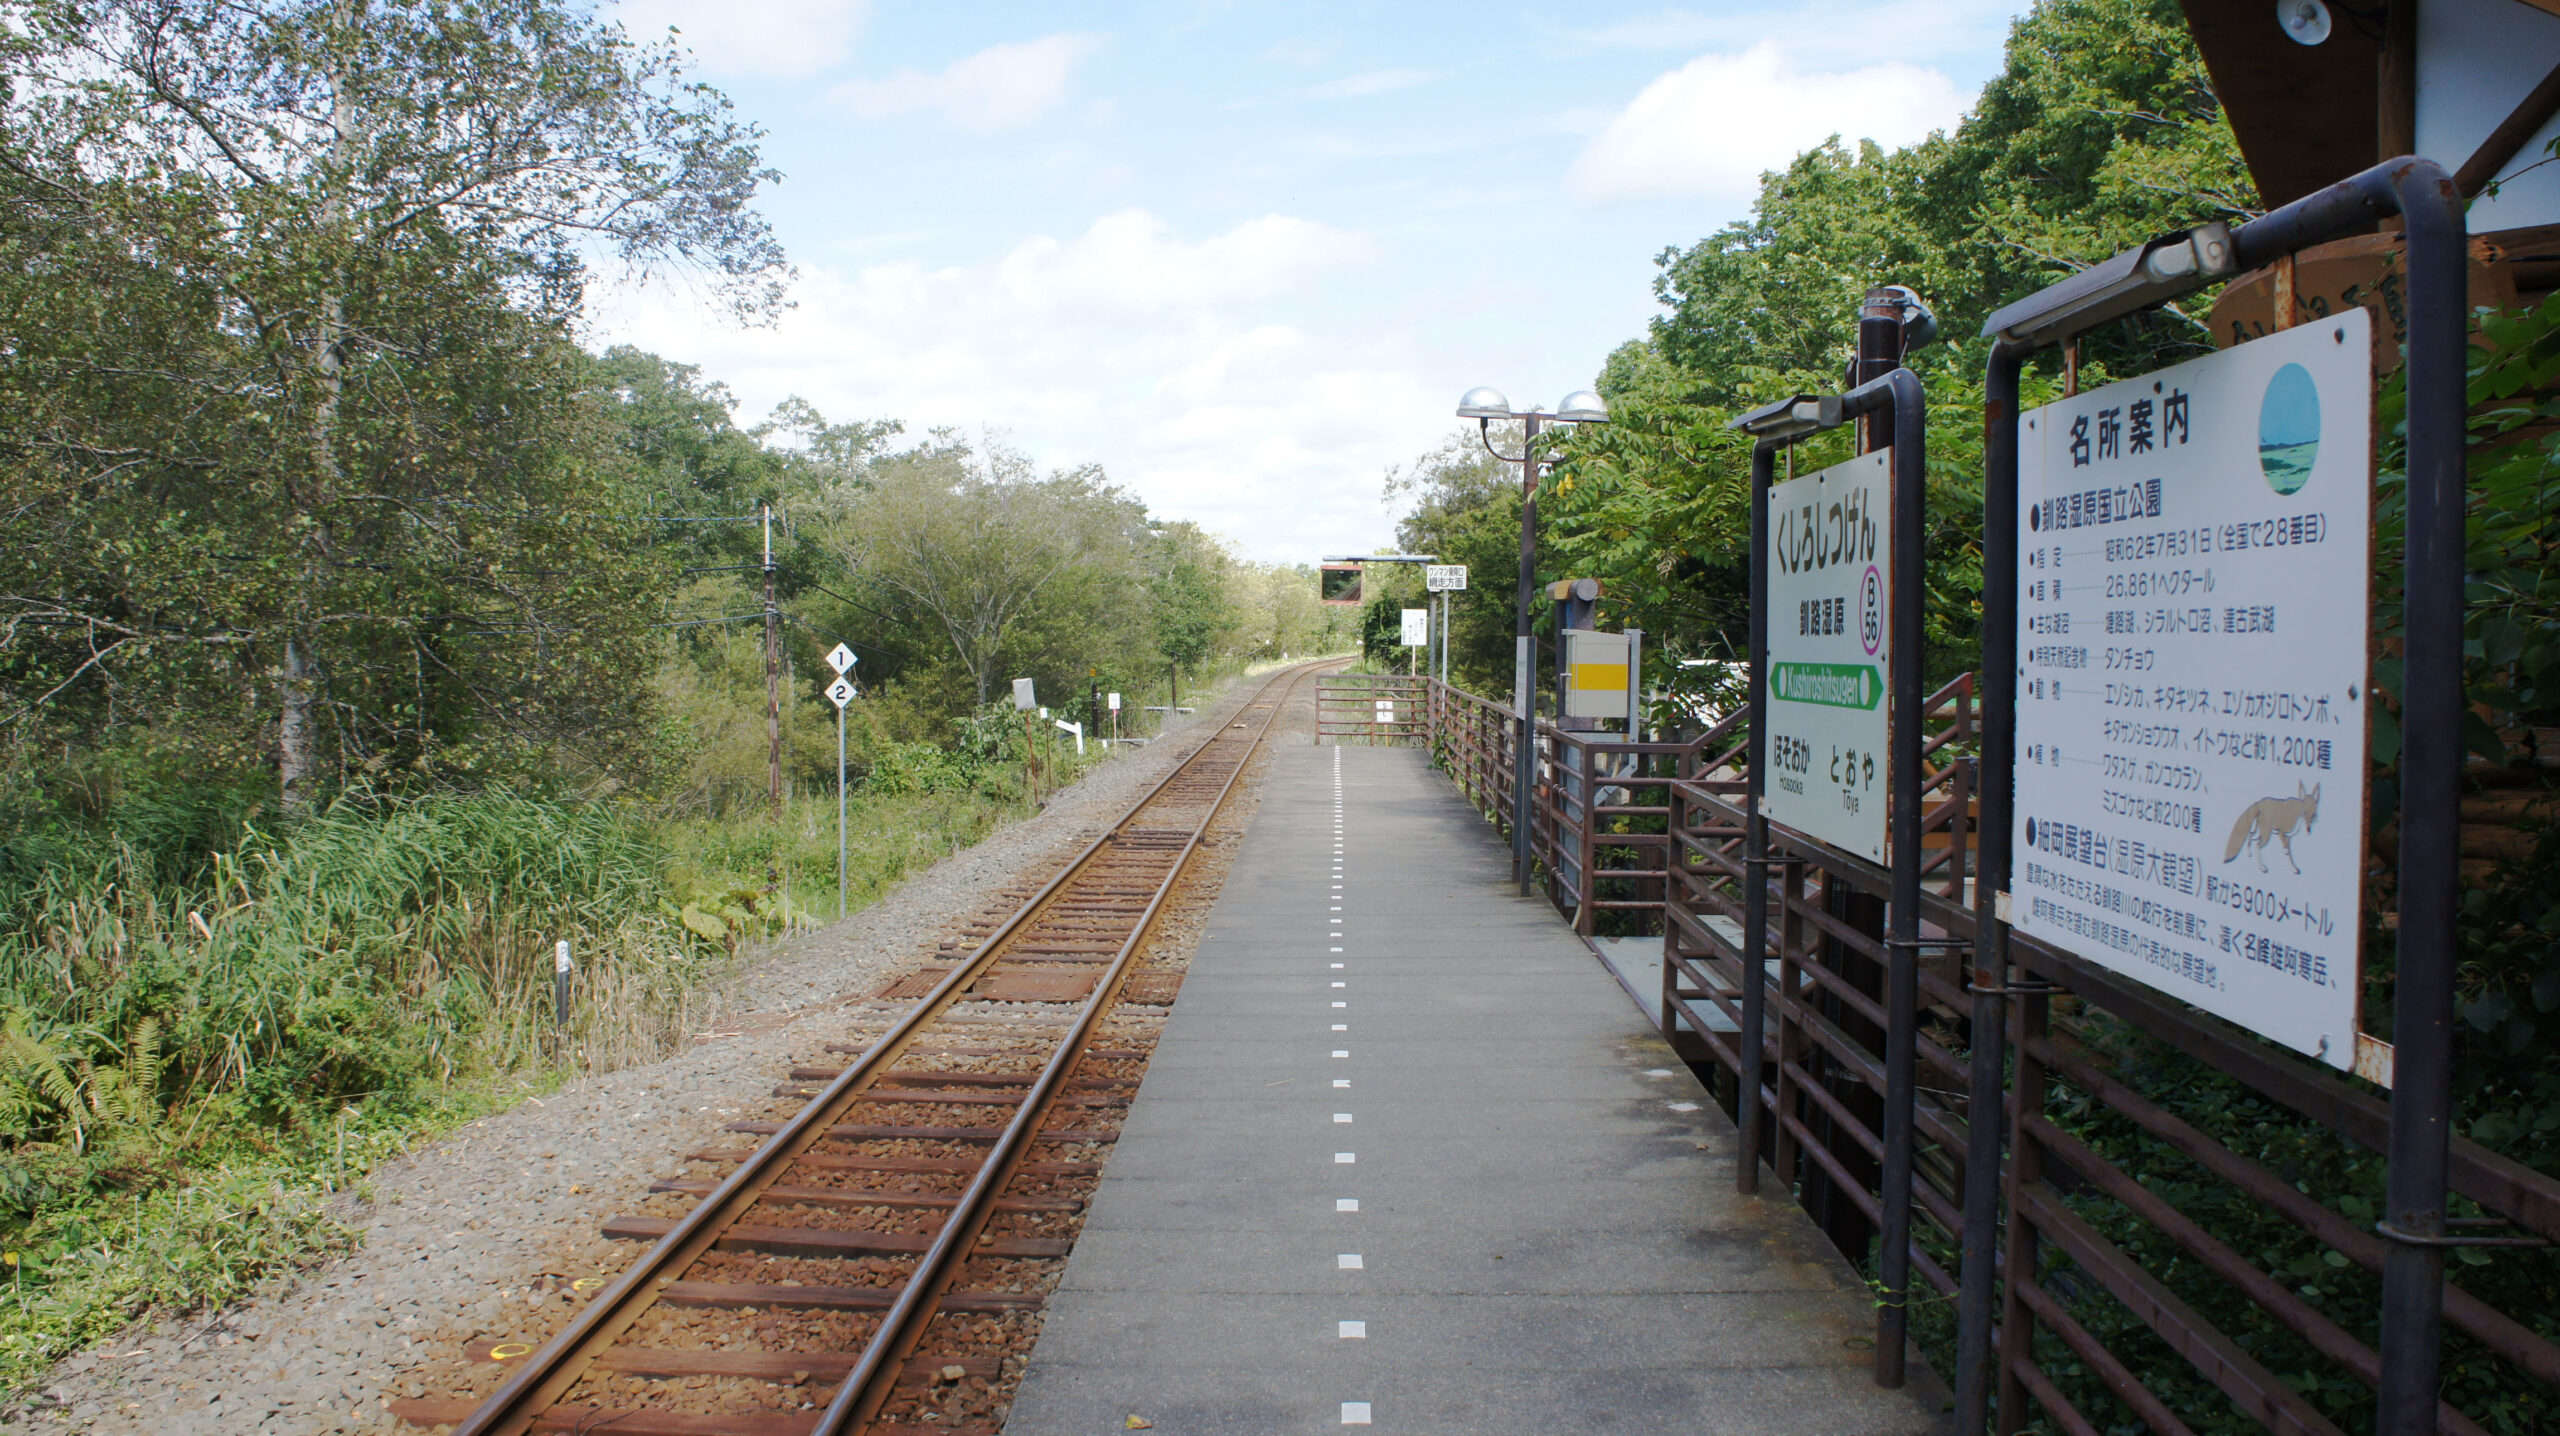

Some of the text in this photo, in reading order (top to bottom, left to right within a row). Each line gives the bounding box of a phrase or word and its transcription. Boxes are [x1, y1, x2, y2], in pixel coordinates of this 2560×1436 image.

[2069, 388, 2189, 468] 名所案内
[2042, 477, 2161, 532] 釧路湿原国立公園
[1777, 487, 1876, 576] くしろしつげん
[1429, 577, 1464, 588] 網走方面
[1867, 577, 1876, 607] B
[1799, 597, 1845, 637] 釧路湿原
[1864, 610, 1878, 643] 56
[837, 652, 844, 666] 1
[2104, 647, 2154, 672] タンチョウ
[836, 684, 845, 700] 2
[1786, 666, 1859, 707] Kushiroshitsugen
[1773, 733, 1811, 775] ほそおか
[1779, 772, 1804, 796] Hosooka
[2102, 789, 2202, 834] ミズゴケなど約200種
[2207, 875, 2334, 937] 駅から900メートル
